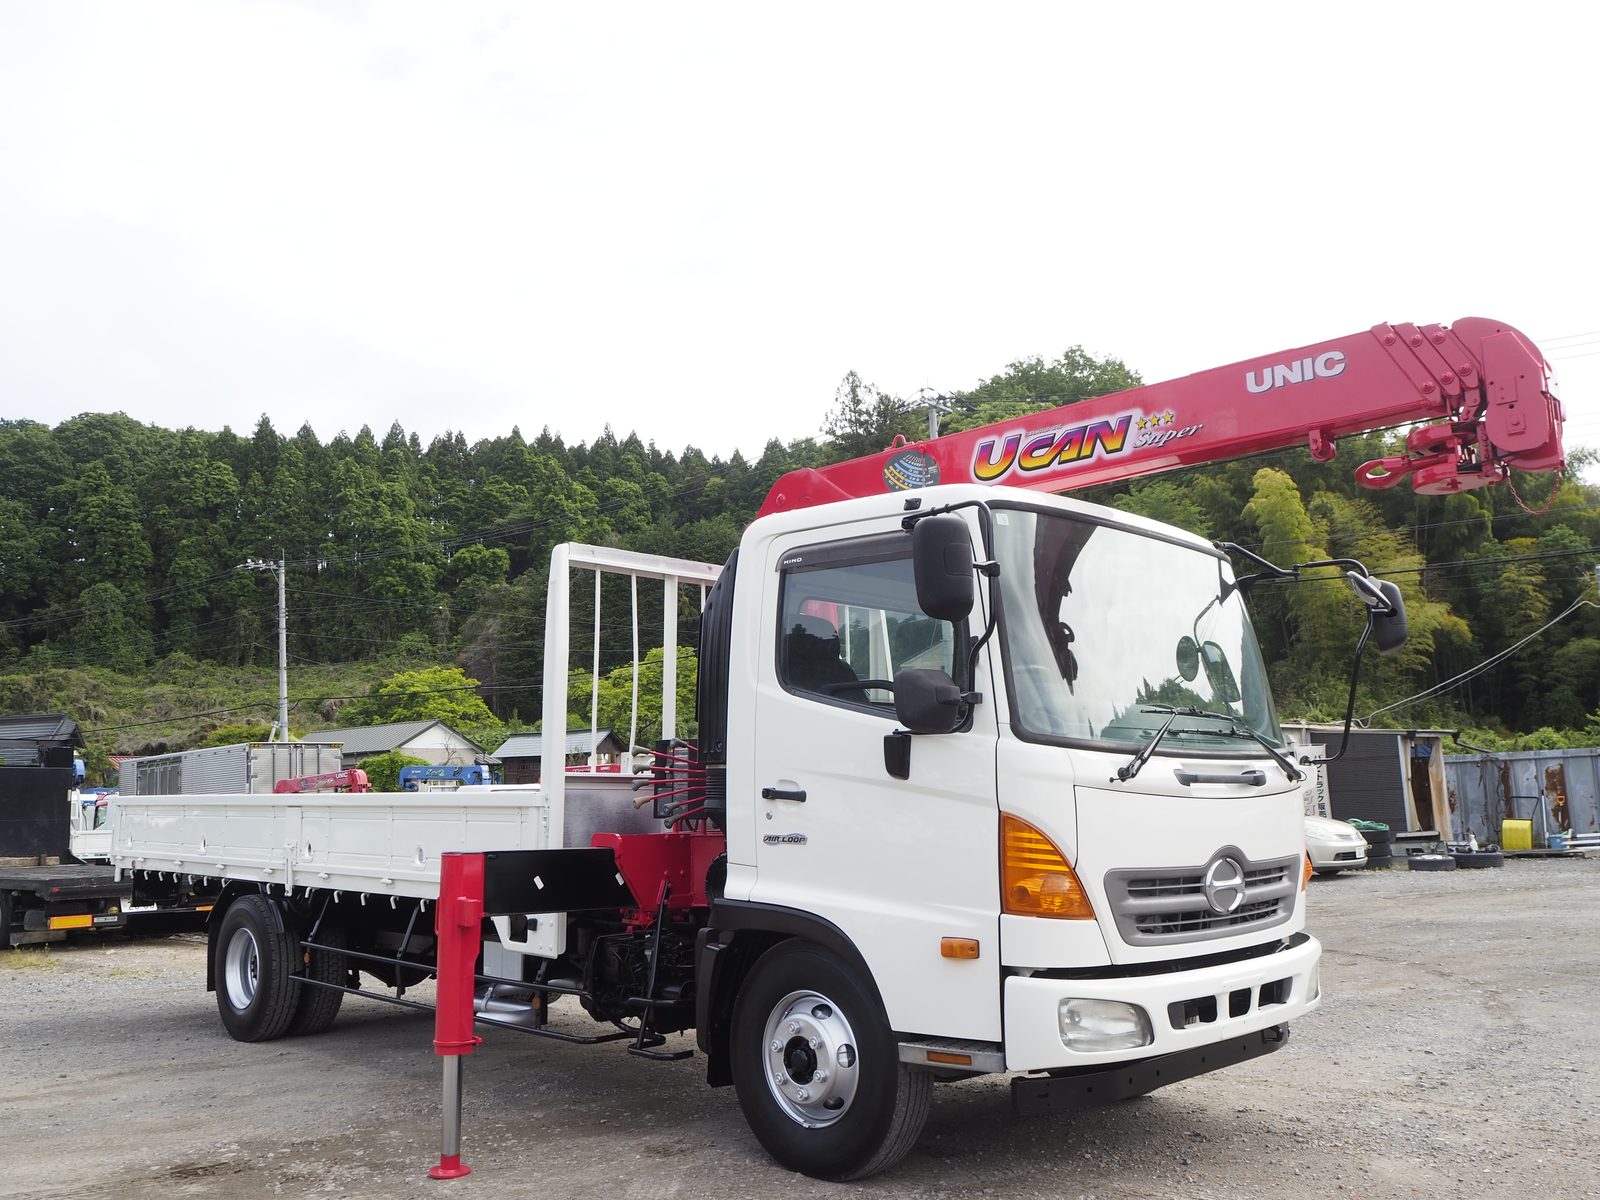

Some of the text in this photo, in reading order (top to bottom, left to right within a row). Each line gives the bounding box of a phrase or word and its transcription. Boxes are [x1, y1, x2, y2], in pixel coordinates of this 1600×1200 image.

[1246, 350, 1346, 394] UNIC
[973, 414, 1133, 481] UCAN
[1133, 422, 1204, 449] Super
